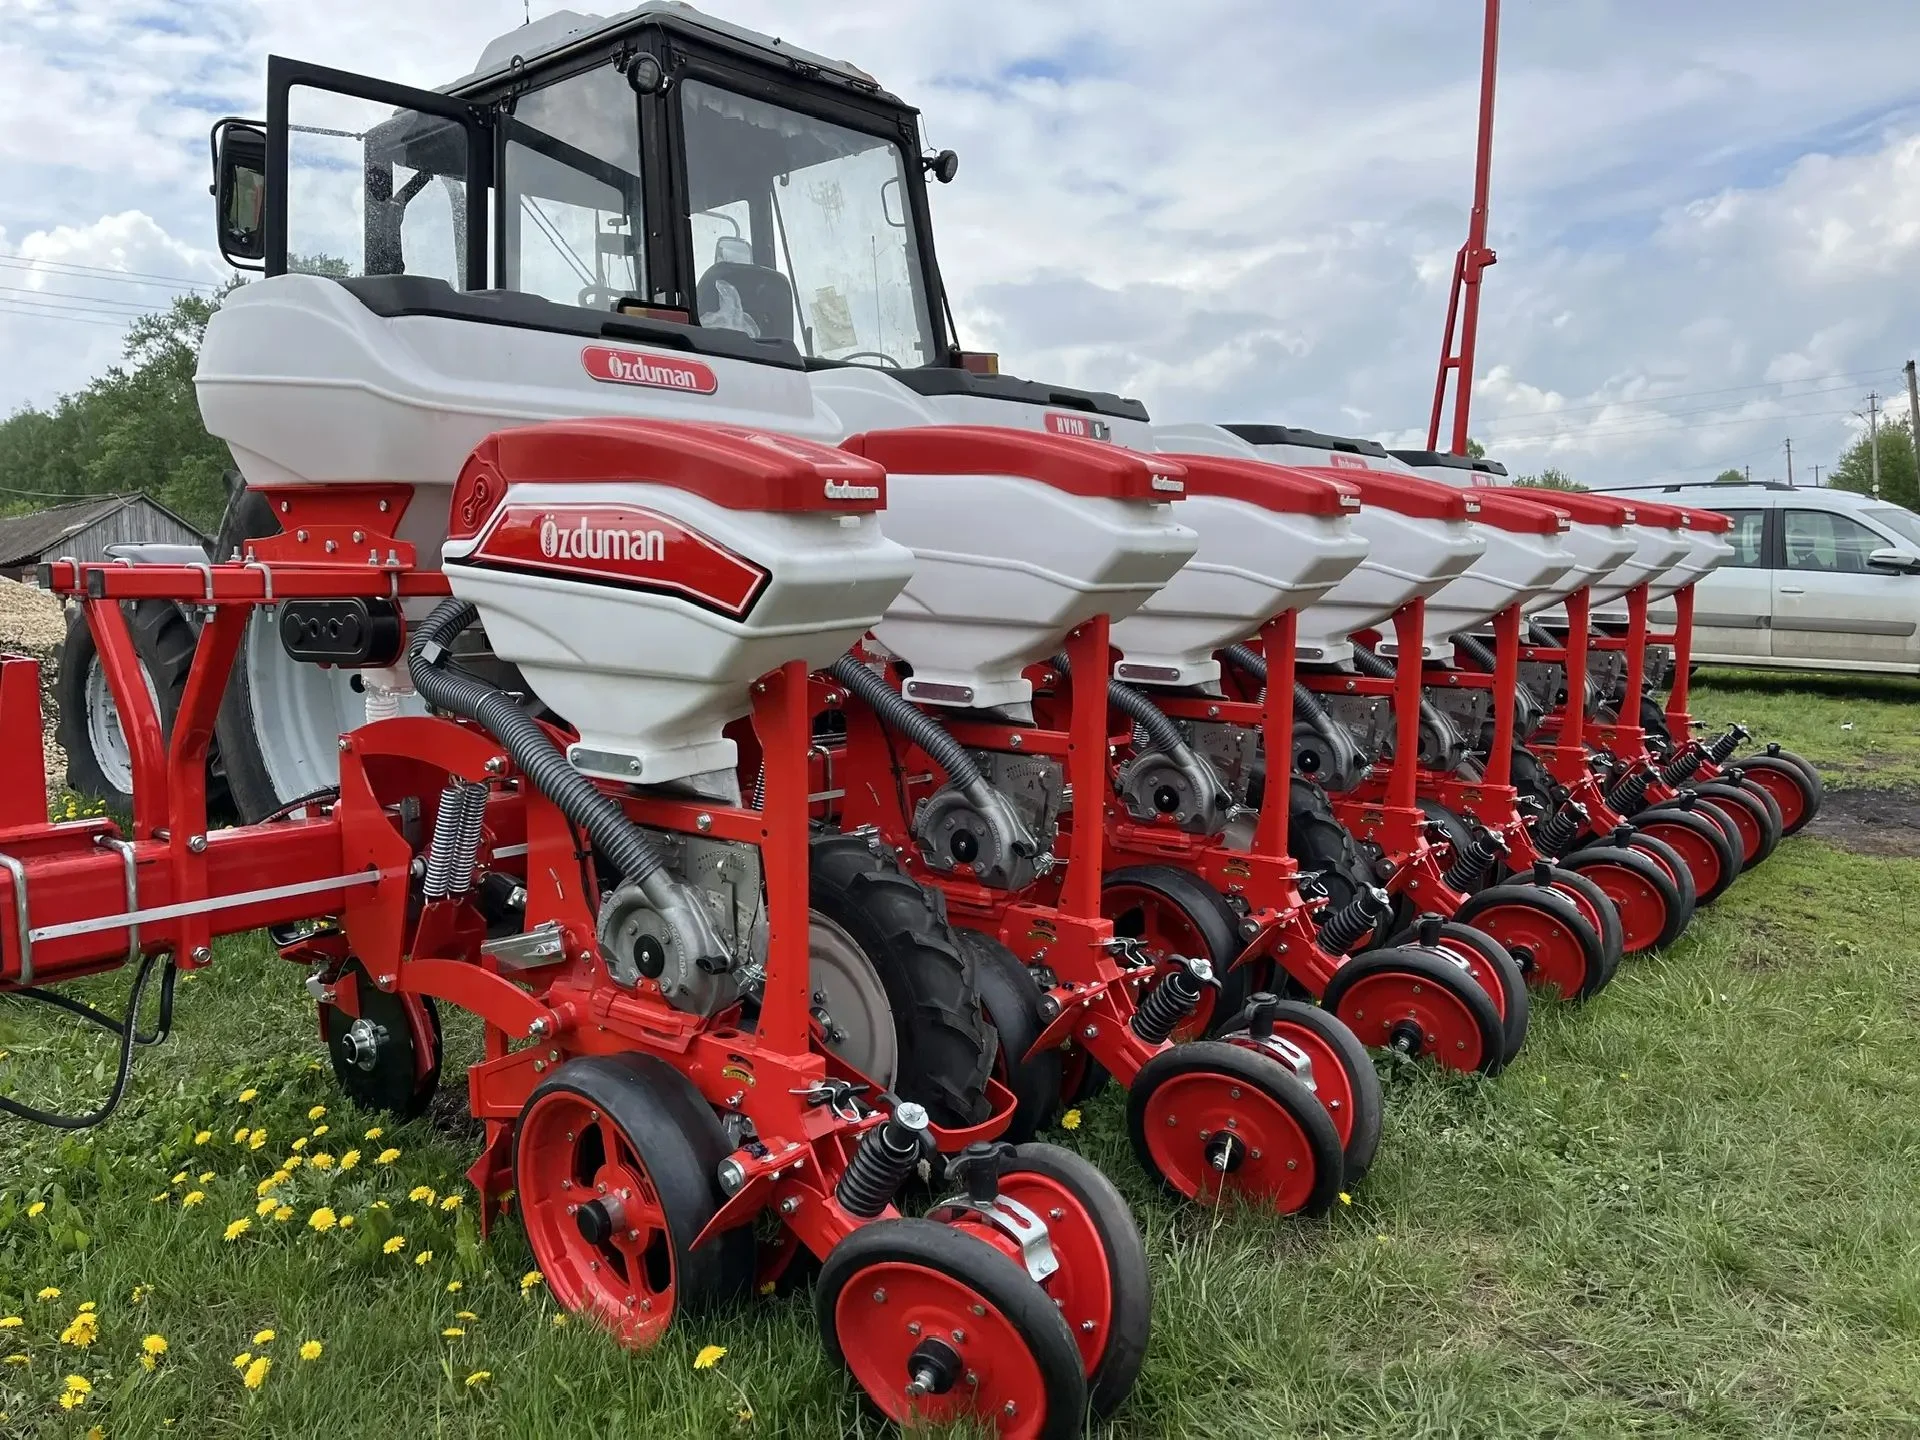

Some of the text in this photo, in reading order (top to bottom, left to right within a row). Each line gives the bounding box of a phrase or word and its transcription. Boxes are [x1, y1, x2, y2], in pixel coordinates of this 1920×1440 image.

[607, 351, 697, 388] Özduman
[1056, 416, 1085, 436] HVMD
[824, 478, 879, 499] Özduman
[540, 513, 665, 562] Özduman
